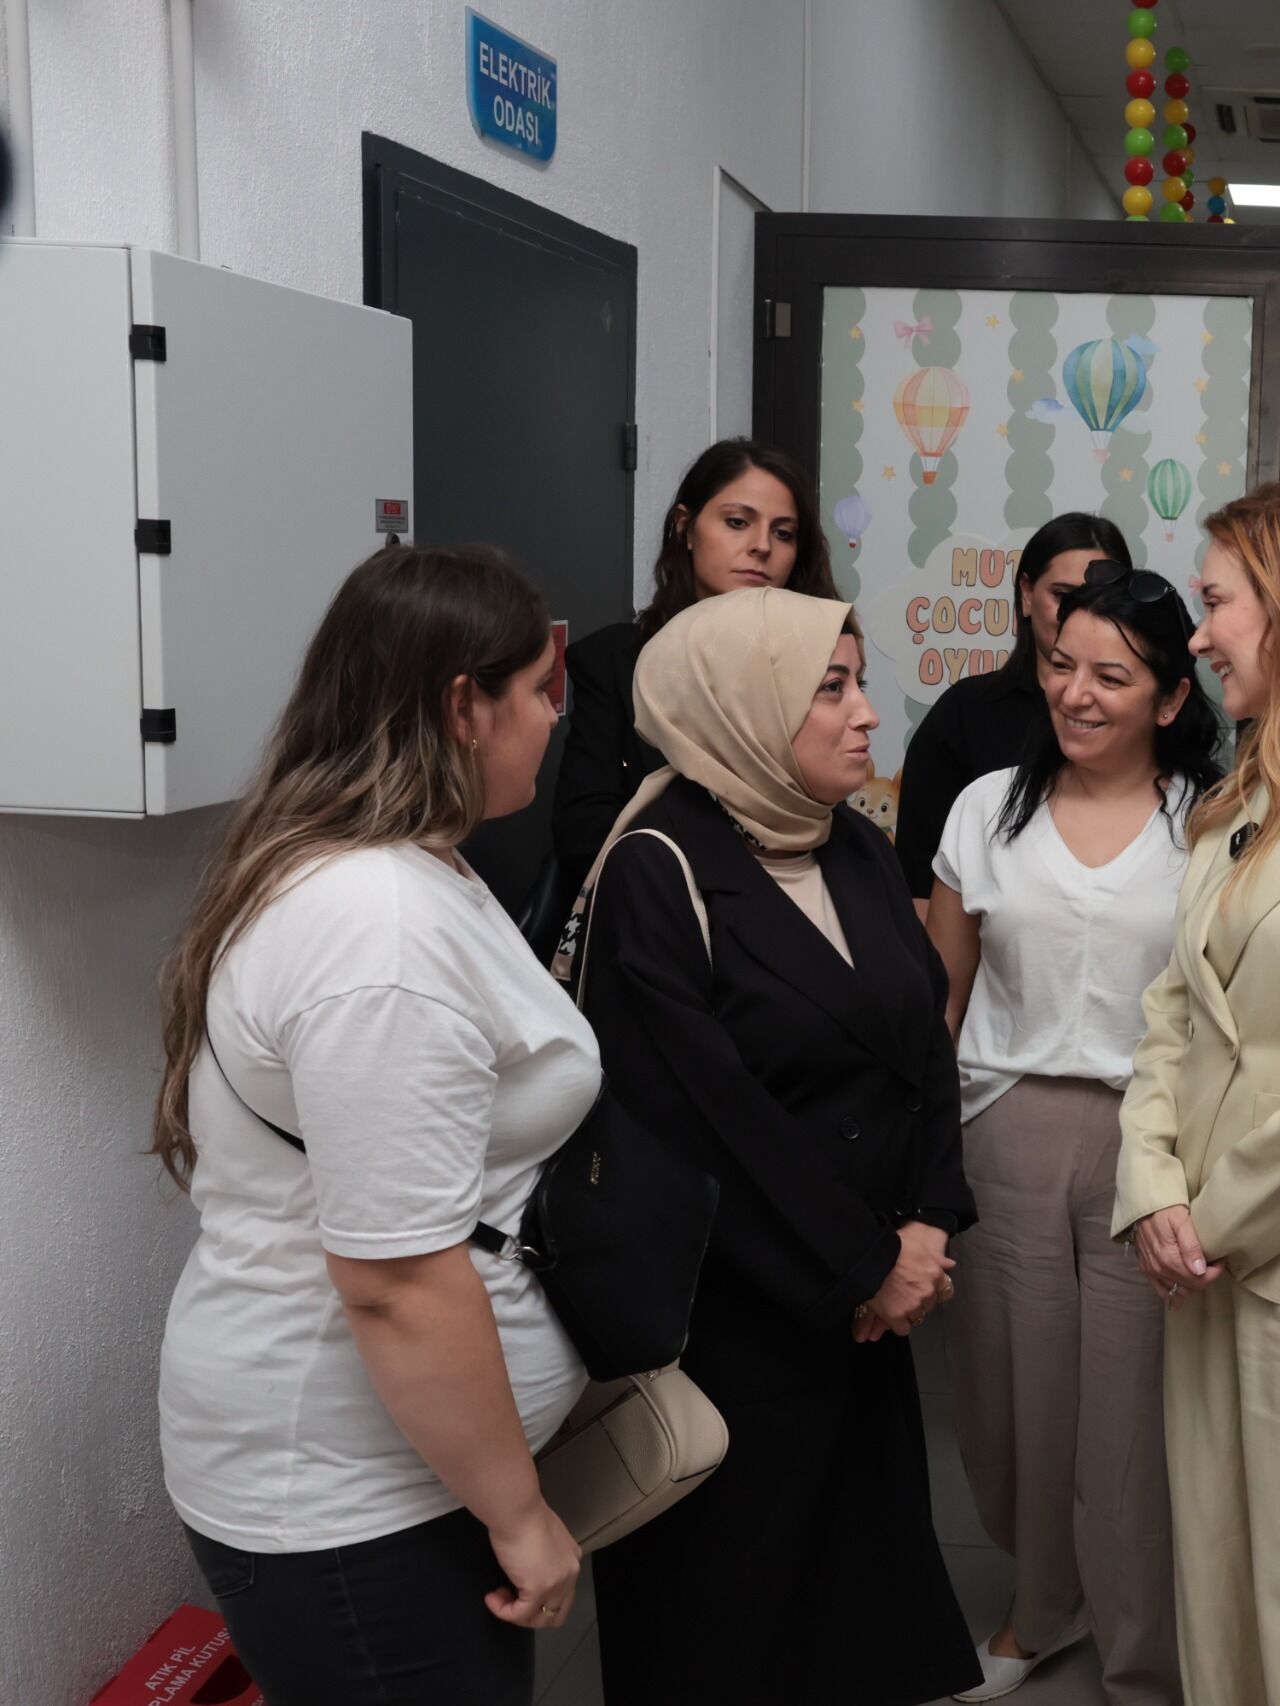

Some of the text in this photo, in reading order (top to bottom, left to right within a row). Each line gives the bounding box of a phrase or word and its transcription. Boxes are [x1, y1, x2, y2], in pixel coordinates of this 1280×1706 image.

[480, 41, 551, 110] ELEKTRİK
[493, 95, 539, 145] ODASI
[906, 596, 1018, 645] ÇOCU
[144, 1646, 196, 1691] ATIK PİL
[188, 1627, 231, 1668] KUTUS
